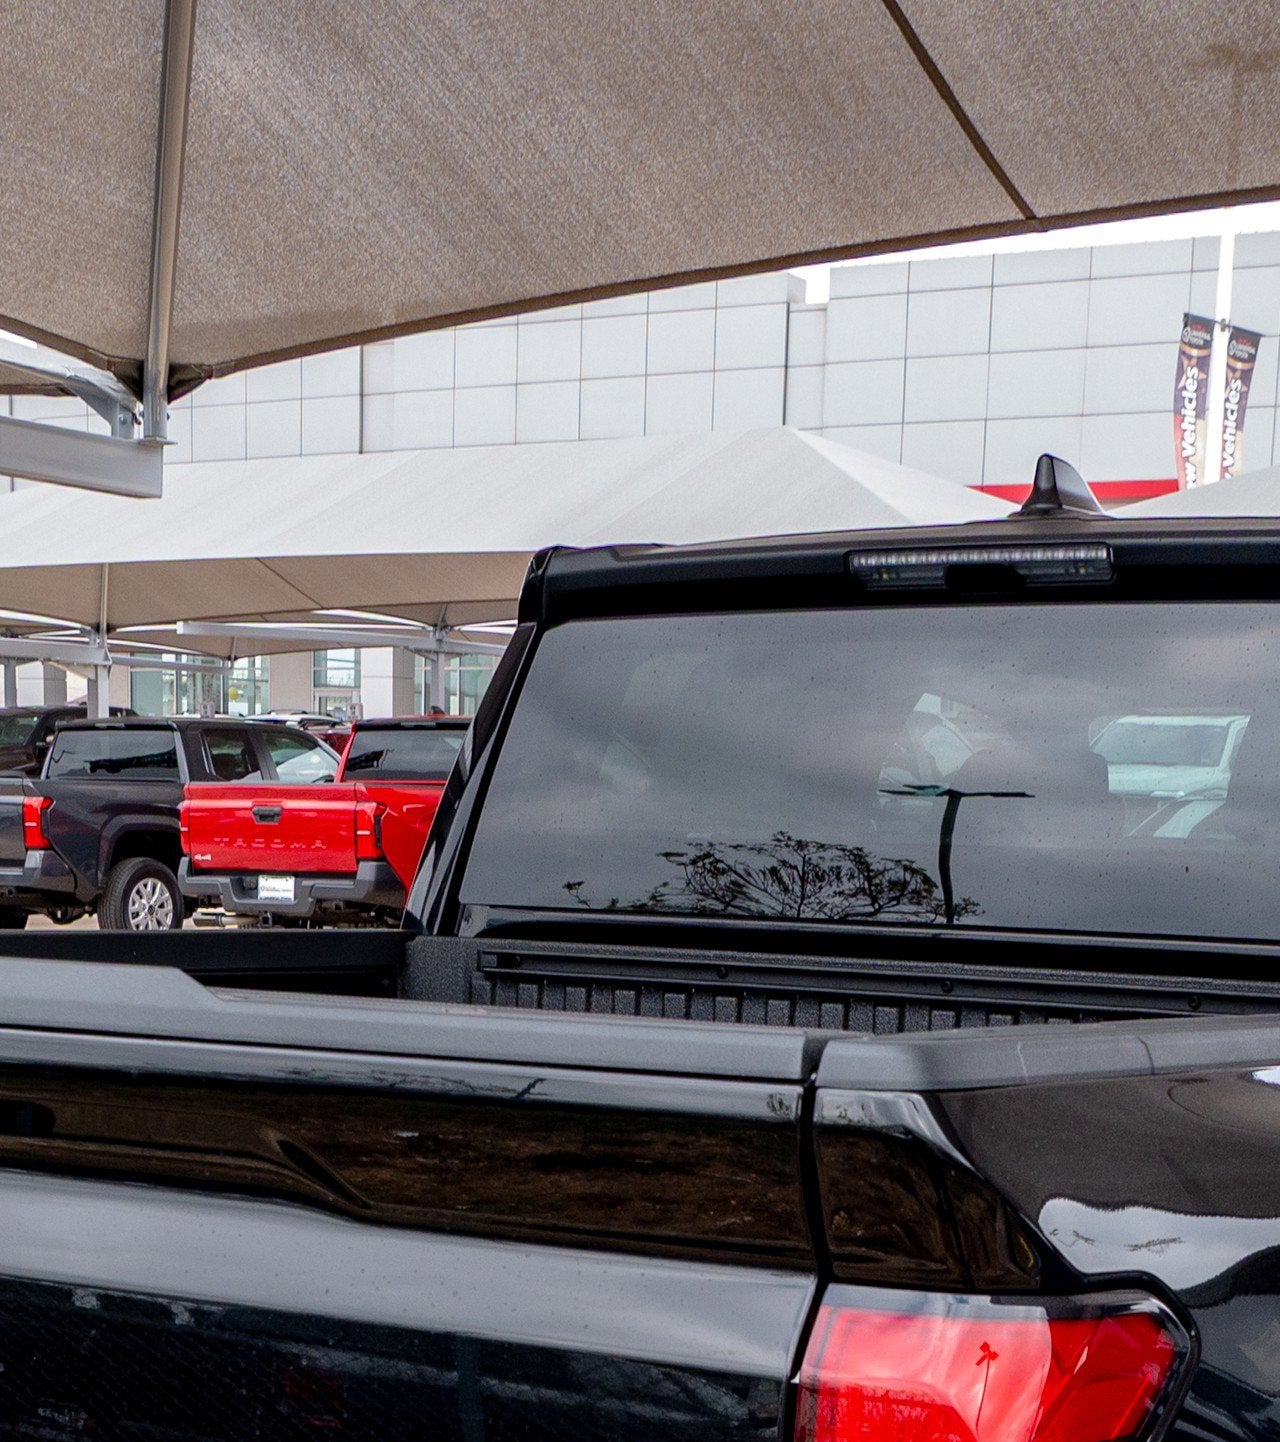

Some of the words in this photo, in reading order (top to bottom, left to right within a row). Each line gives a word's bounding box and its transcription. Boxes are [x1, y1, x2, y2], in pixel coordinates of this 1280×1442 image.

[1180, 366, 1199, 458] Vehicles
[1222, 378, 1242, 468] Vehicles
[213, 837, 327, 850] TACOMA
